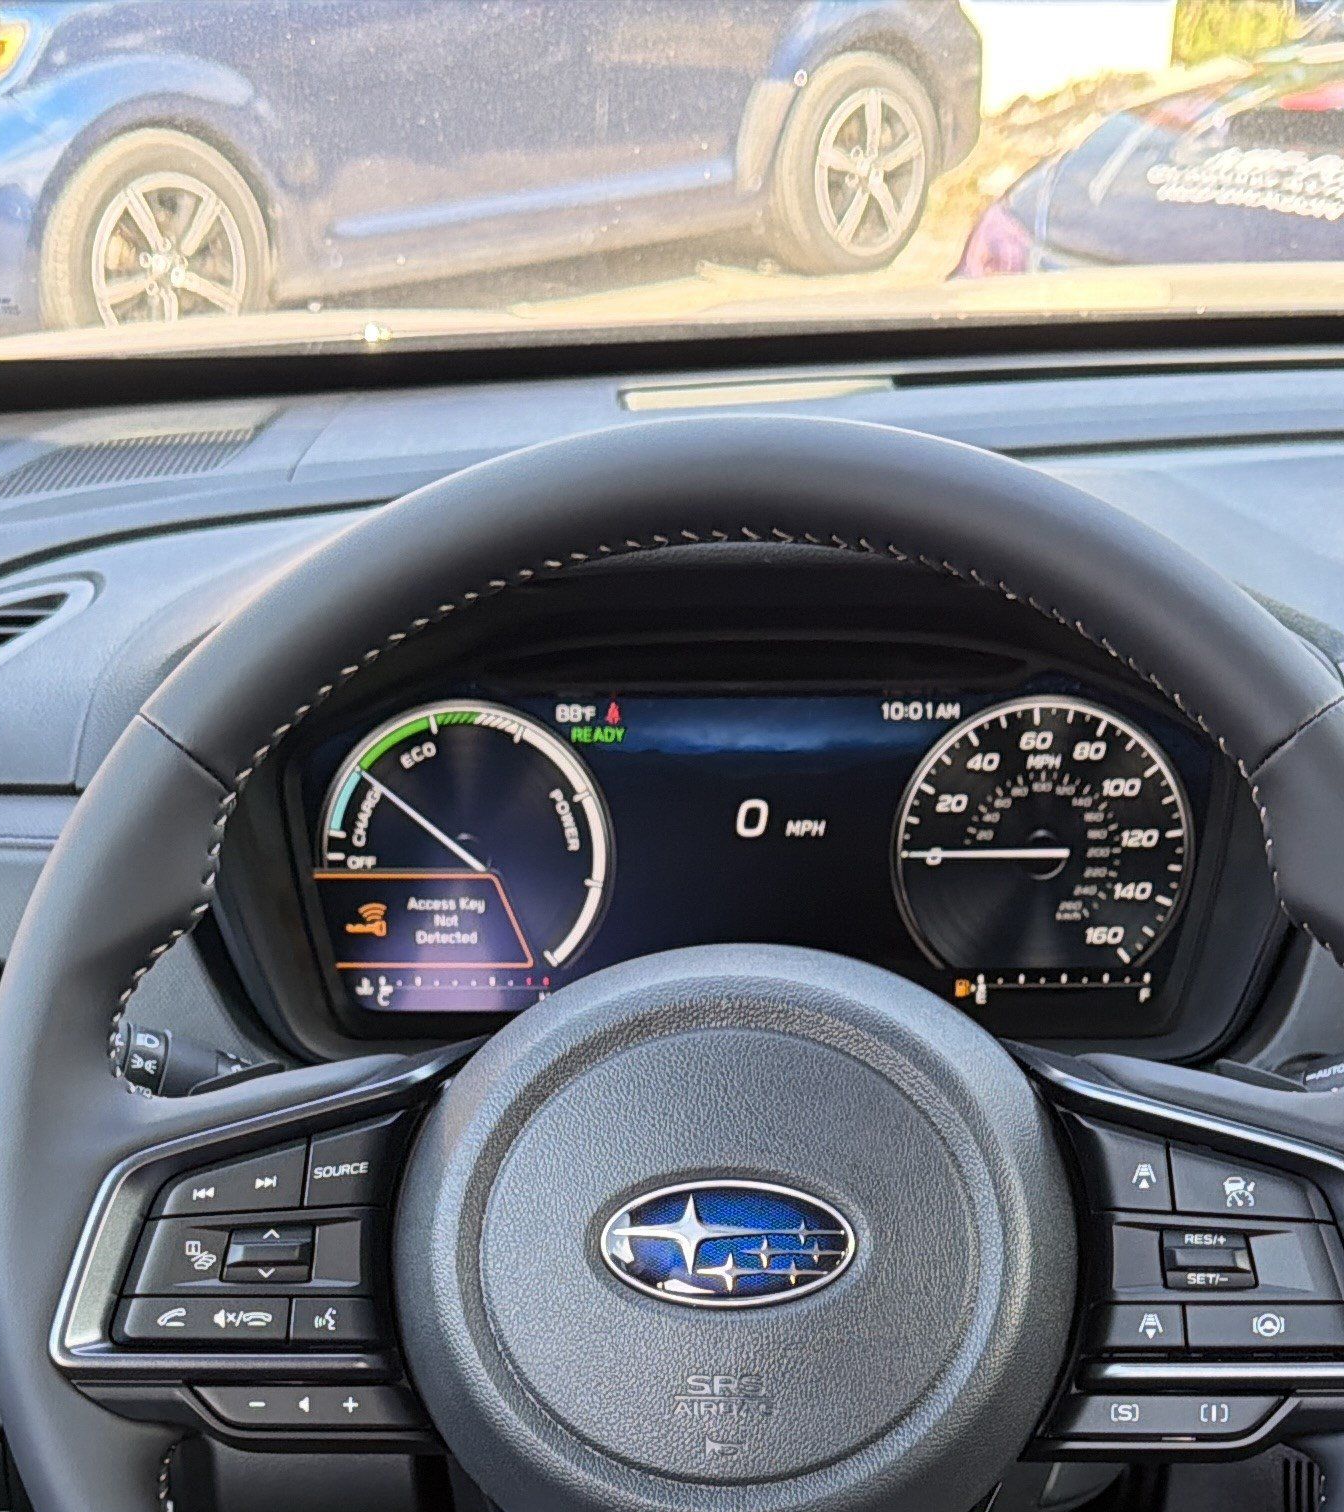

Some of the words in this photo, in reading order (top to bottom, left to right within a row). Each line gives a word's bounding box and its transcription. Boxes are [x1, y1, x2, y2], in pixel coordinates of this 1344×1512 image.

[570, 726, 625, 743] READY
[1019, 731, 1053, 751] 60
[399, 741, 437, 769] ECO
[1072, 741, 1108, 761] 80
[966, 752, 1001, 772] 40
[1025, 753, 1062, 770] MPH
[1101, 778, 1142, 798] 100
[934, 794, 968, 814] 20
[352, 784, 383, 847] CHARG
[548, 788, 581, 852] POWER
[735, 798, 769, 838] 0
[785, 819, 827, 837] MPH
[1121, 829, 1160, 848] 120
[346, 855, 377, 870] OFF
[1113, 881, 1153, 901] 140
[407, 896, 456, 911] Access
[458, 896, 486, 914] Key
[433, 914, 459, 927] Not
[415, 930, 478, 945] Detected
[1084, 926, 1125, 946] 160
[313, 1162, 369, 1180] SOURCE
[686, 1374, 762, 1395] SRS
[673, 1400, 774, 1417] AIRB
